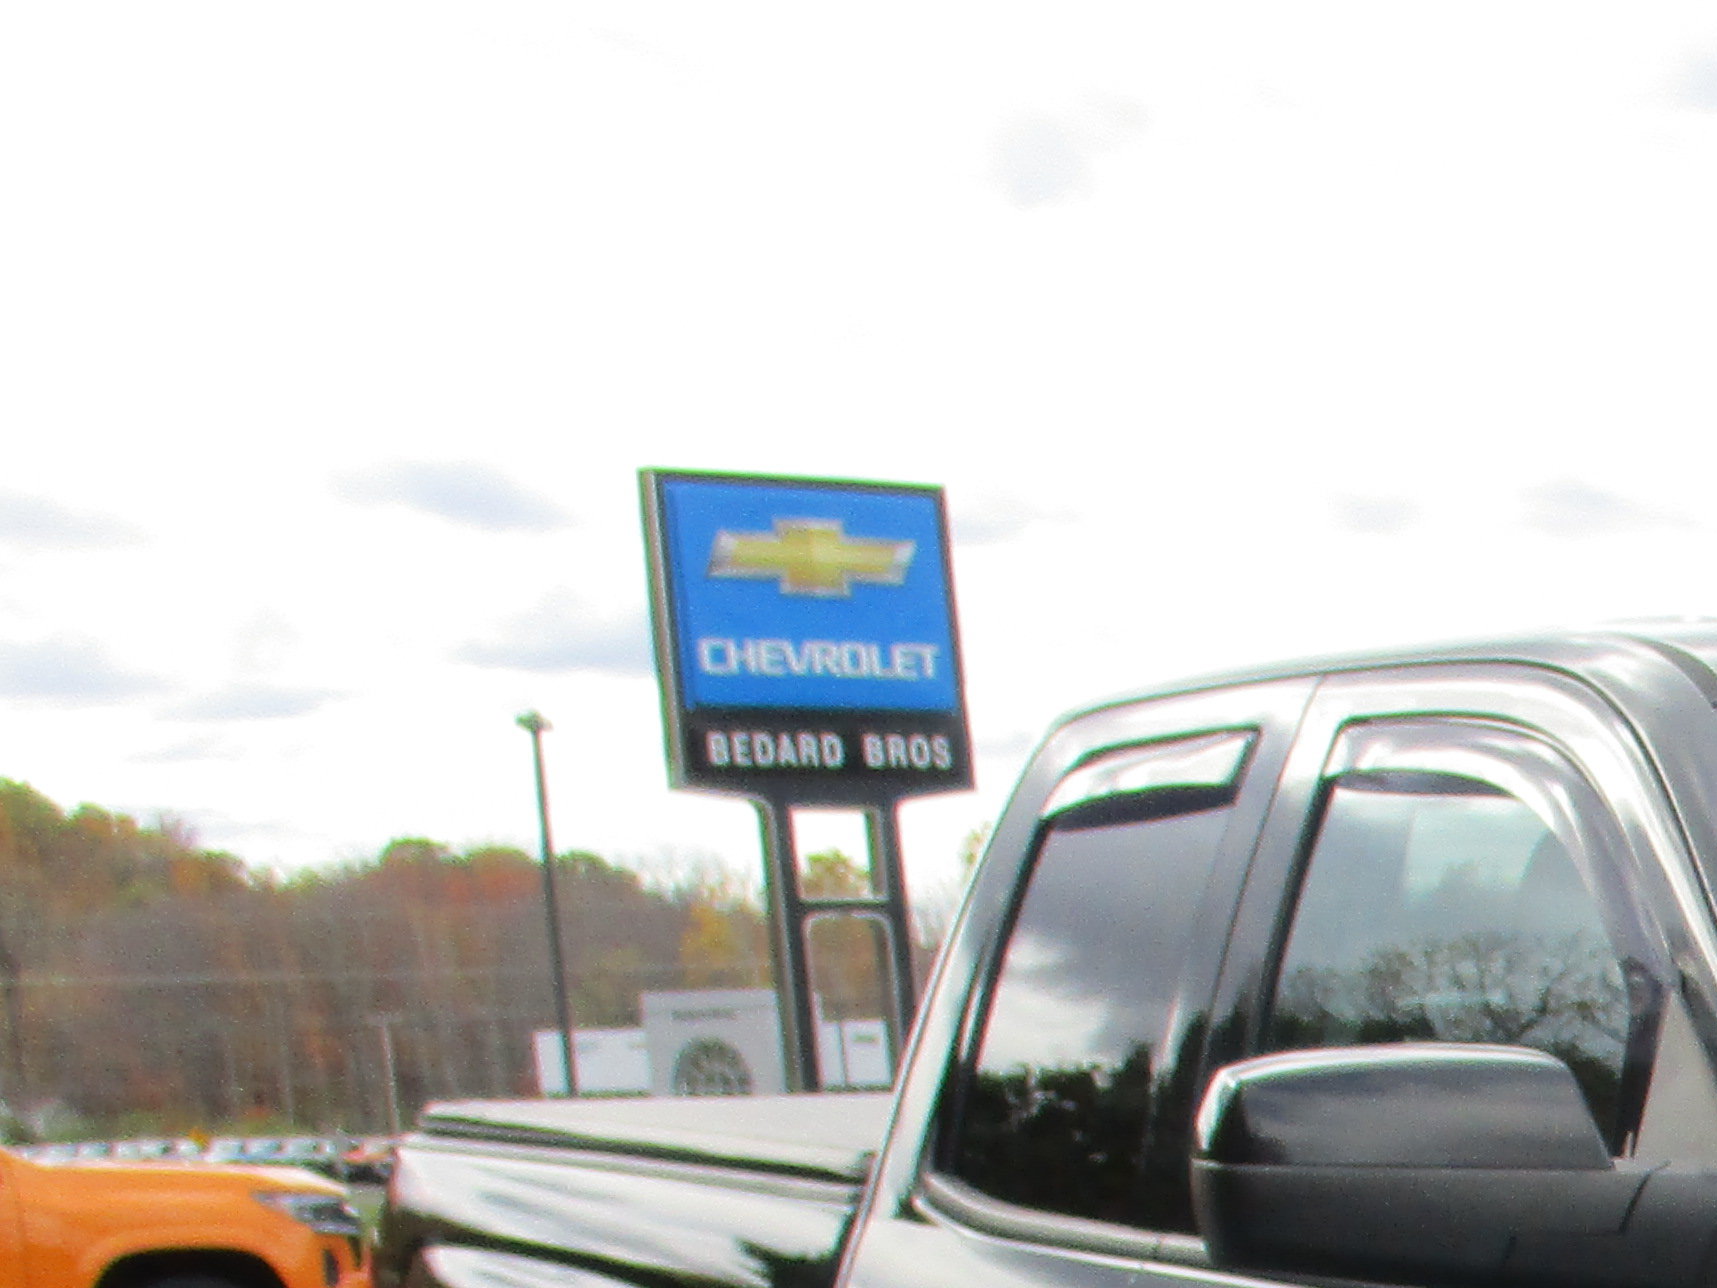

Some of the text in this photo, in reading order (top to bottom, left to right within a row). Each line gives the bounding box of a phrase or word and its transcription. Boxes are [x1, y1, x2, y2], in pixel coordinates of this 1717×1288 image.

[697, 637, 939, 680] CHEVROLET
[705, 730, 952, 771] BEDARD BROS
